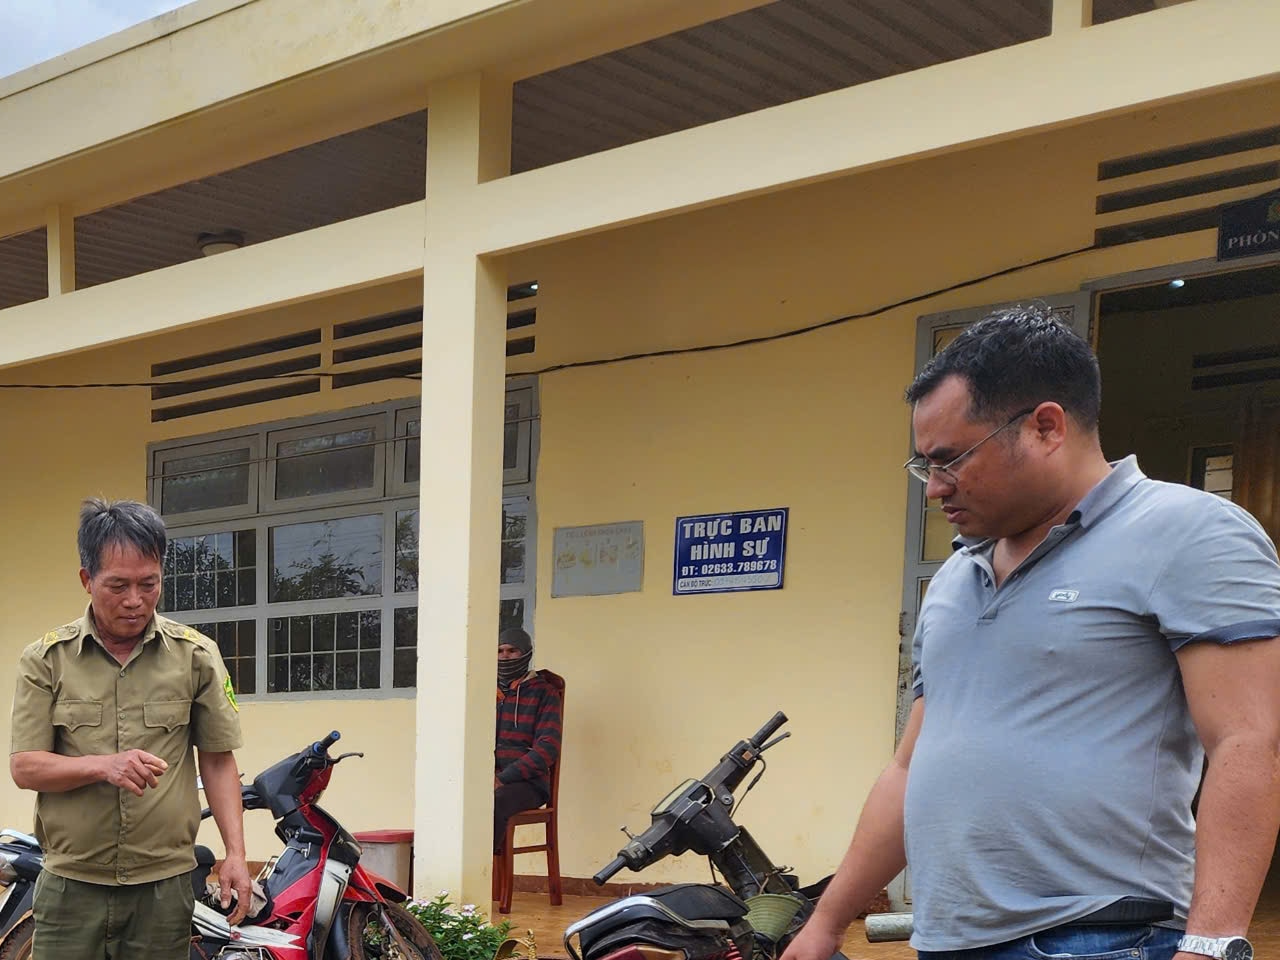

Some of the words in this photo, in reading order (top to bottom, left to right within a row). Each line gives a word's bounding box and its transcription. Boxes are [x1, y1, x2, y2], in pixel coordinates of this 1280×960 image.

[683, 518, 733, 540] TRỰC
[740, 515, 782, 534] BAN
[690, 541, 736, 561] HÌNH
[742, 536, 770, 558] SỰ
[681, 566, 699, 576] ĐT:
[701, 560, 777, 575] 02633.789678
